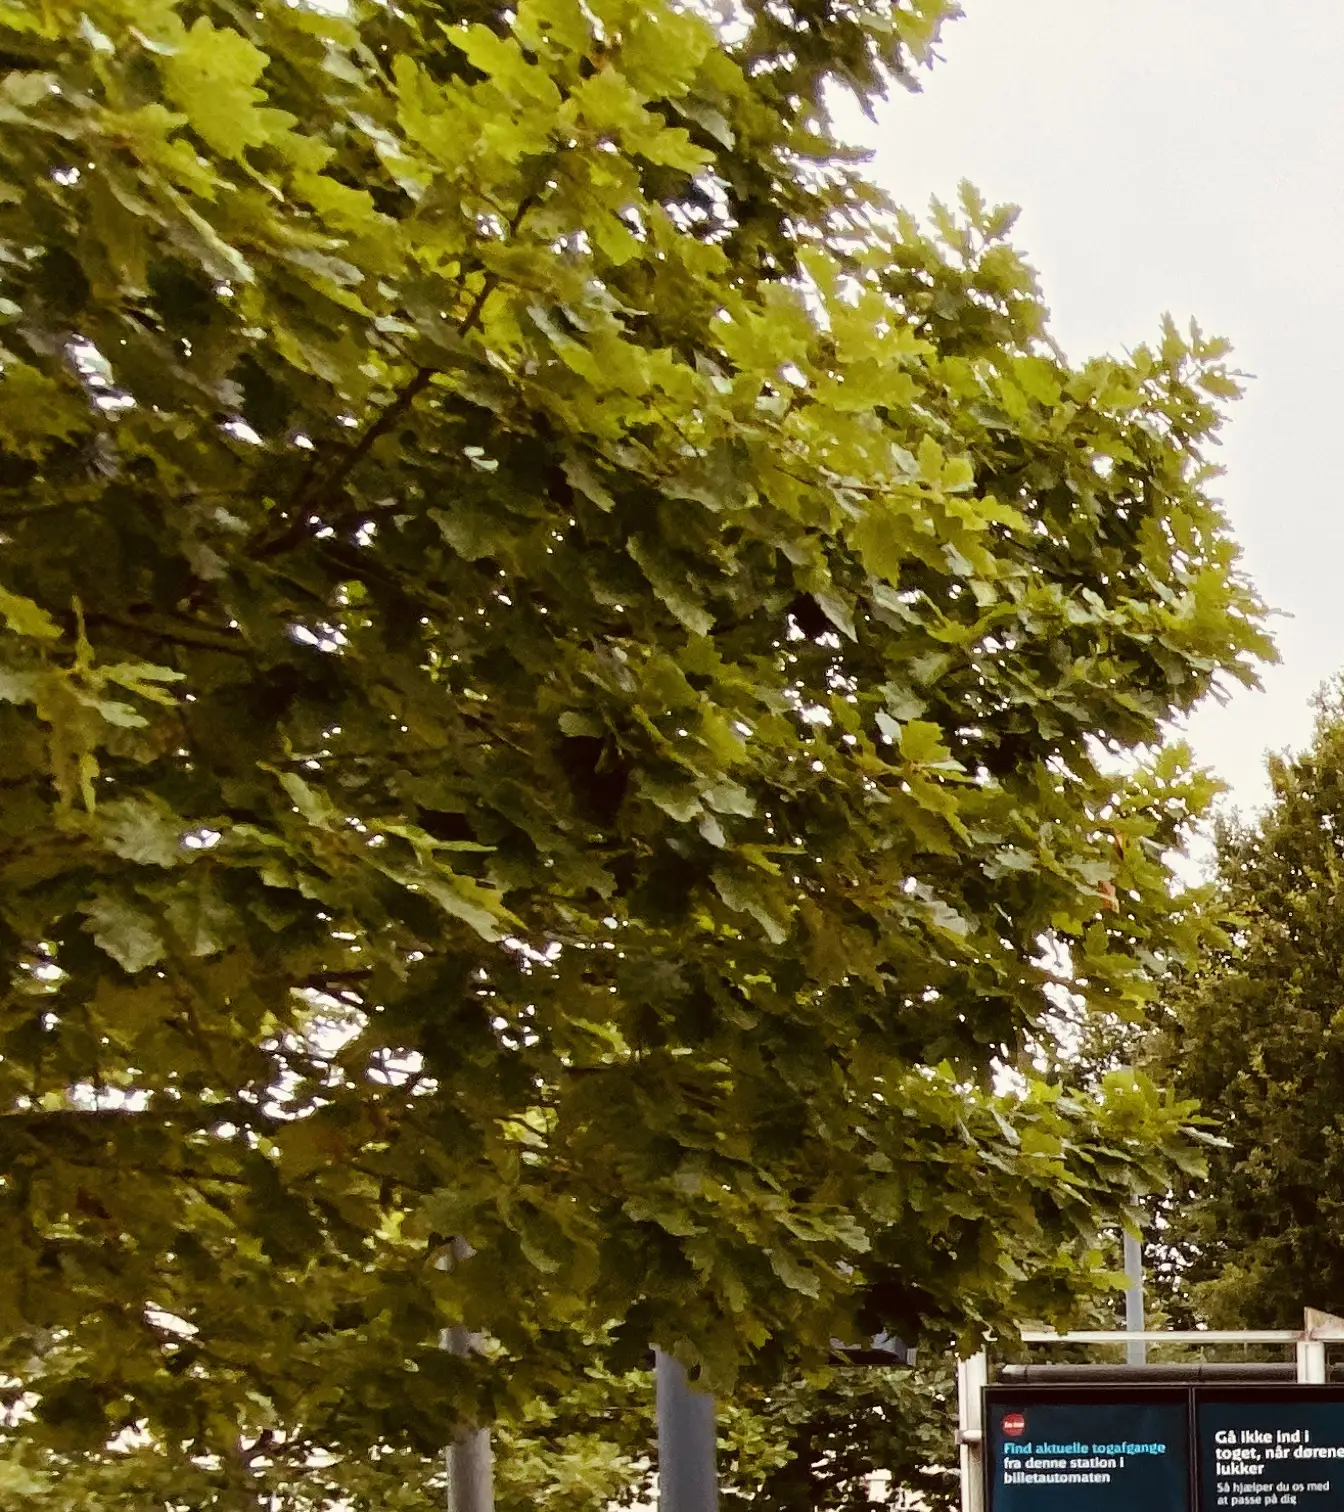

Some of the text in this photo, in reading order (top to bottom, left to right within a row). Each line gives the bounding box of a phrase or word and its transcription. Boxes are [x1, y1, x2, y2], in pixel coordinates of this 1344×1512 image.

[1215, 1429, 1310, 1444] Gå ikke ind i
[1003, 1442, 1032, 1454] Find
[1035, 1442, 1089, 1454] aktuelle
[1215, 1447, 1262, 1461] toget,
[1265, 1445, 1290, 1459] når
[1003, 1456, 1125, 1469] fra denne station i
[1216, 1462, 1265, 1475] lukker
[1003, 1471, 1111, 1484] billetautomaten
[1217, 1481, 1330, 1495] Så hjælper du os med
[1217, 1494, 1297, 1507] at passe på dig
